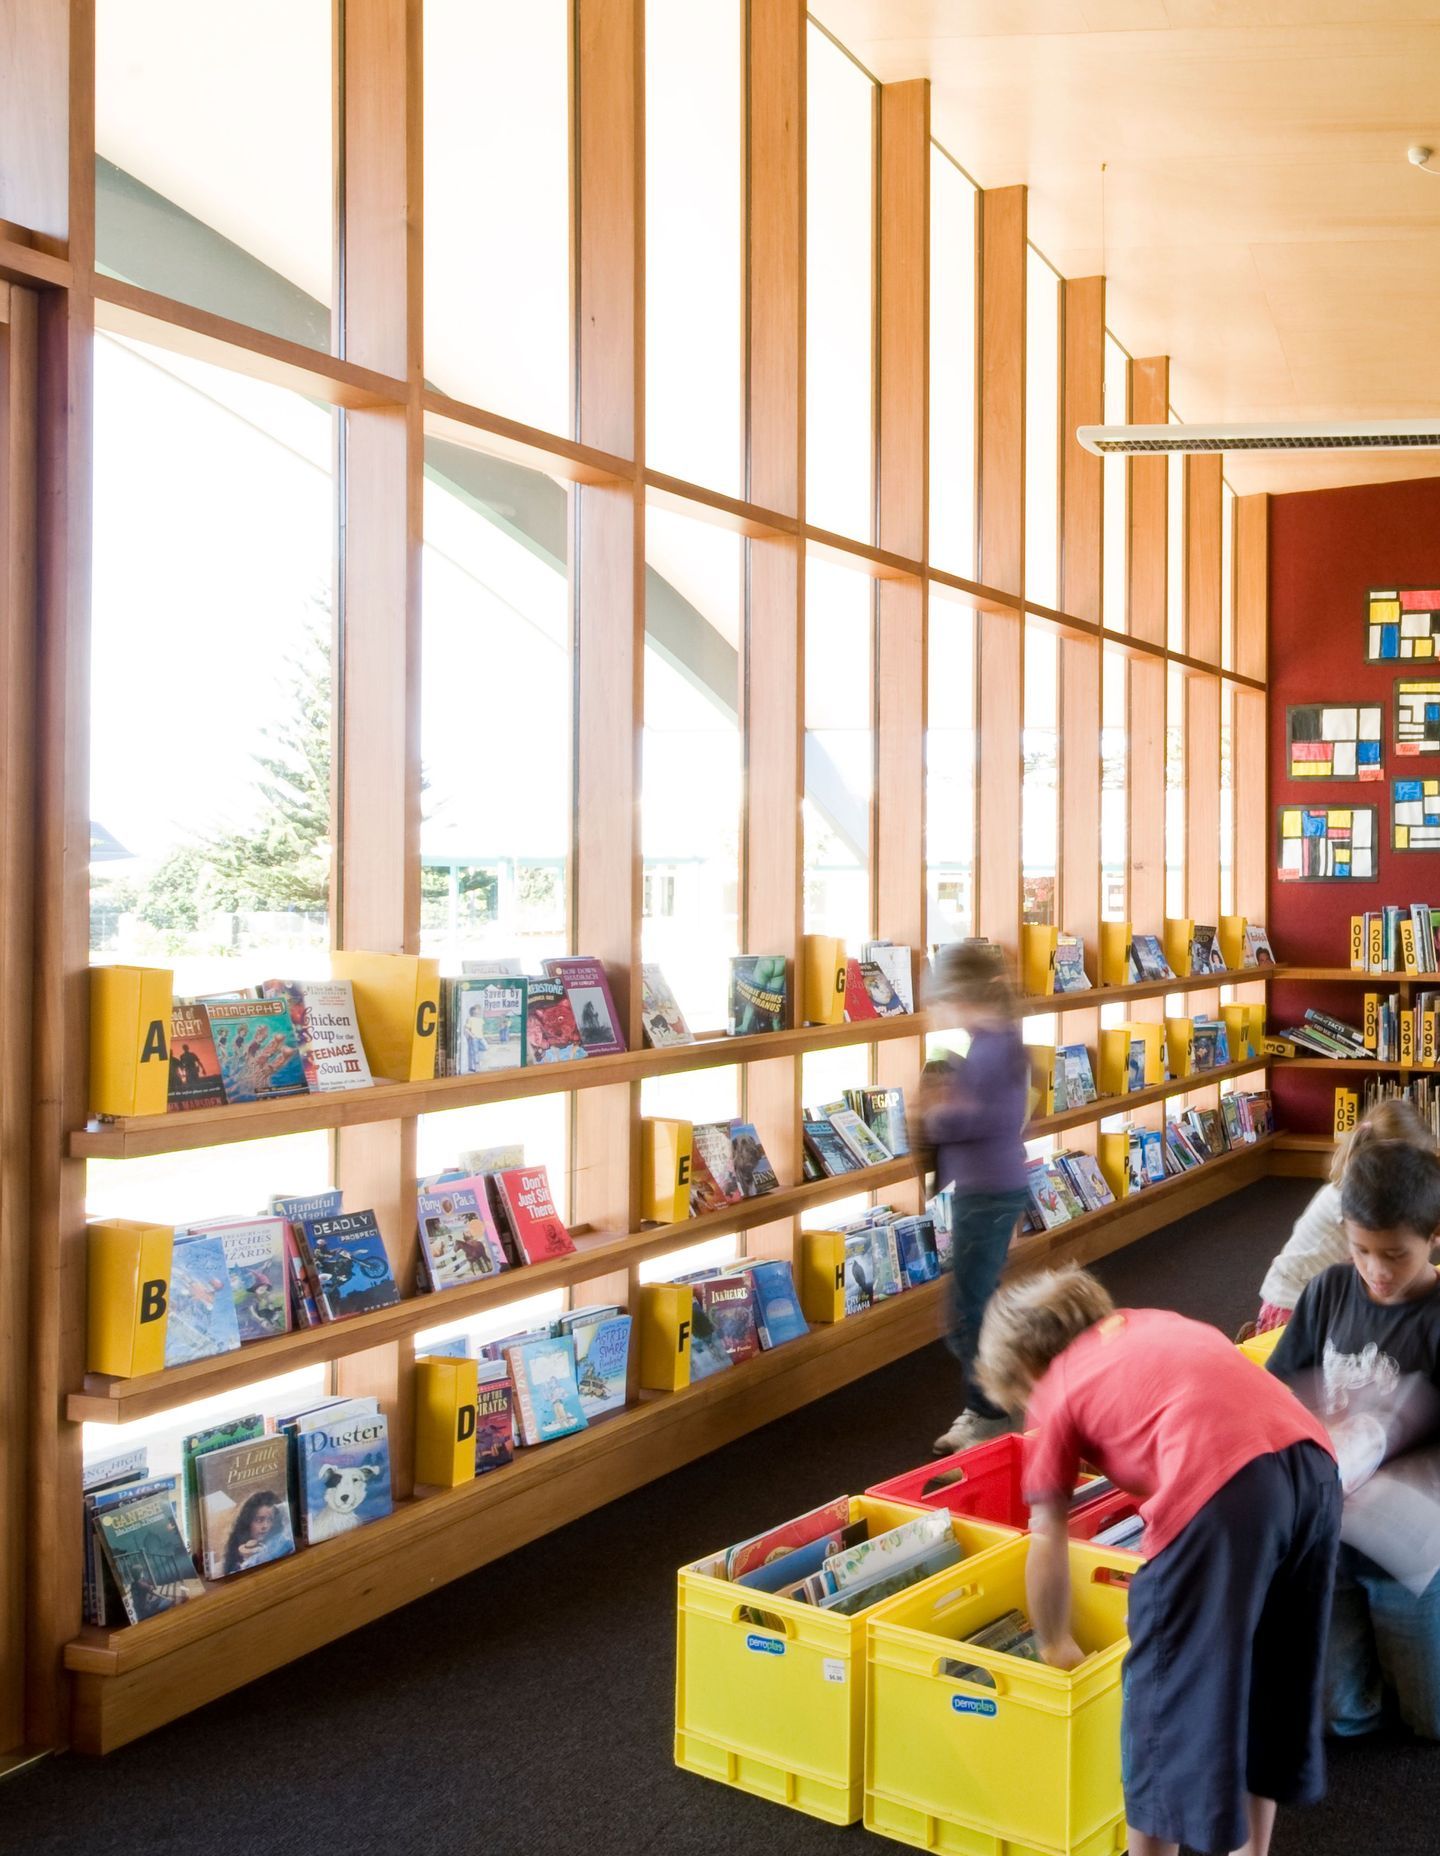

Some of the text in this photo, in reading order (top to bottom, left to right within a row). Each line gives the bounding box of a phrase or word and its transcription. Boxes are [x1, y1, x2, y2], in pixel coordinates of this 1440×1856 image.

[1353, 924, 1361, 960] 001
[1372, 929, 1381, 965] 200
[1404, 929, 1415, 965] 380
[1049, 950, 1056, 971] K
[836, 967, 846, 994] G
[484, 988, 507, 1000] Saved
[509, 988, 520, 1001] by
[484, 999, 500, 1011] Ryan
[502, 998, 520, 1009] Kane
[751, 996, 782, 1013] URANUS
[760, 992, 783, 1004] BUMS
[207, 1002, 283, 1018] ANIMORPHS
[301, 1007, 351, 1027] Chicken
[416, 1000, 437, 1038] C
[1366, 1001, 1375, 1038] 300
[171, 1020, 203, 1037] IGHT
[302, 1026, 335, 1043] Soup
[1402, 1020, 1411, 1057] 394
[1424, 1020, 1433, 1057] 398
[140, 1020, 168, 1063] A
[307, 1043, 357, 1060] TEENAGE
[320, 1059, 362, 1075] Soul III
[877, 1092, 900, 1108] GAP
[1337, 1096, 1345, 1132] 100
[1347, 1102, 1355, 1132] 35
[678, 1155, 690, 1186] E
[522, 1175, 547, 1190] Don't
[288, 1197, 335, 1215] Handful
[418, 1196, 441, 1214] Pony
[518, 1189, 550, 1208] Just Sit
[528, 1204, 554, 1219] There
[312, 1215, 370, 1236] DEADLY
[224, 1234, 272, 1248] ITCHES
[340, 1229, 378, 1243] PROSPECT
[225, 1248, 272, 1261] IZARDS
[835, 1262, 845, 1291] H
[140, 1280, 168, 1325] B
[712, 1288, 748, 1304] INKHEART
[595, 1328, 628, 1345] ASTRID
[679, 1320, 690, 1352] F
[599, 1343, 625, 1358] SPARK
[457, 1404, 475, 1442] D
[309, 1425, 383, 1453] Duster
[231, 1447, 279, 1469] A Little
[228, 1461, 278, 1484] Princess
[112, 1502, 162, 1529] GANESH
